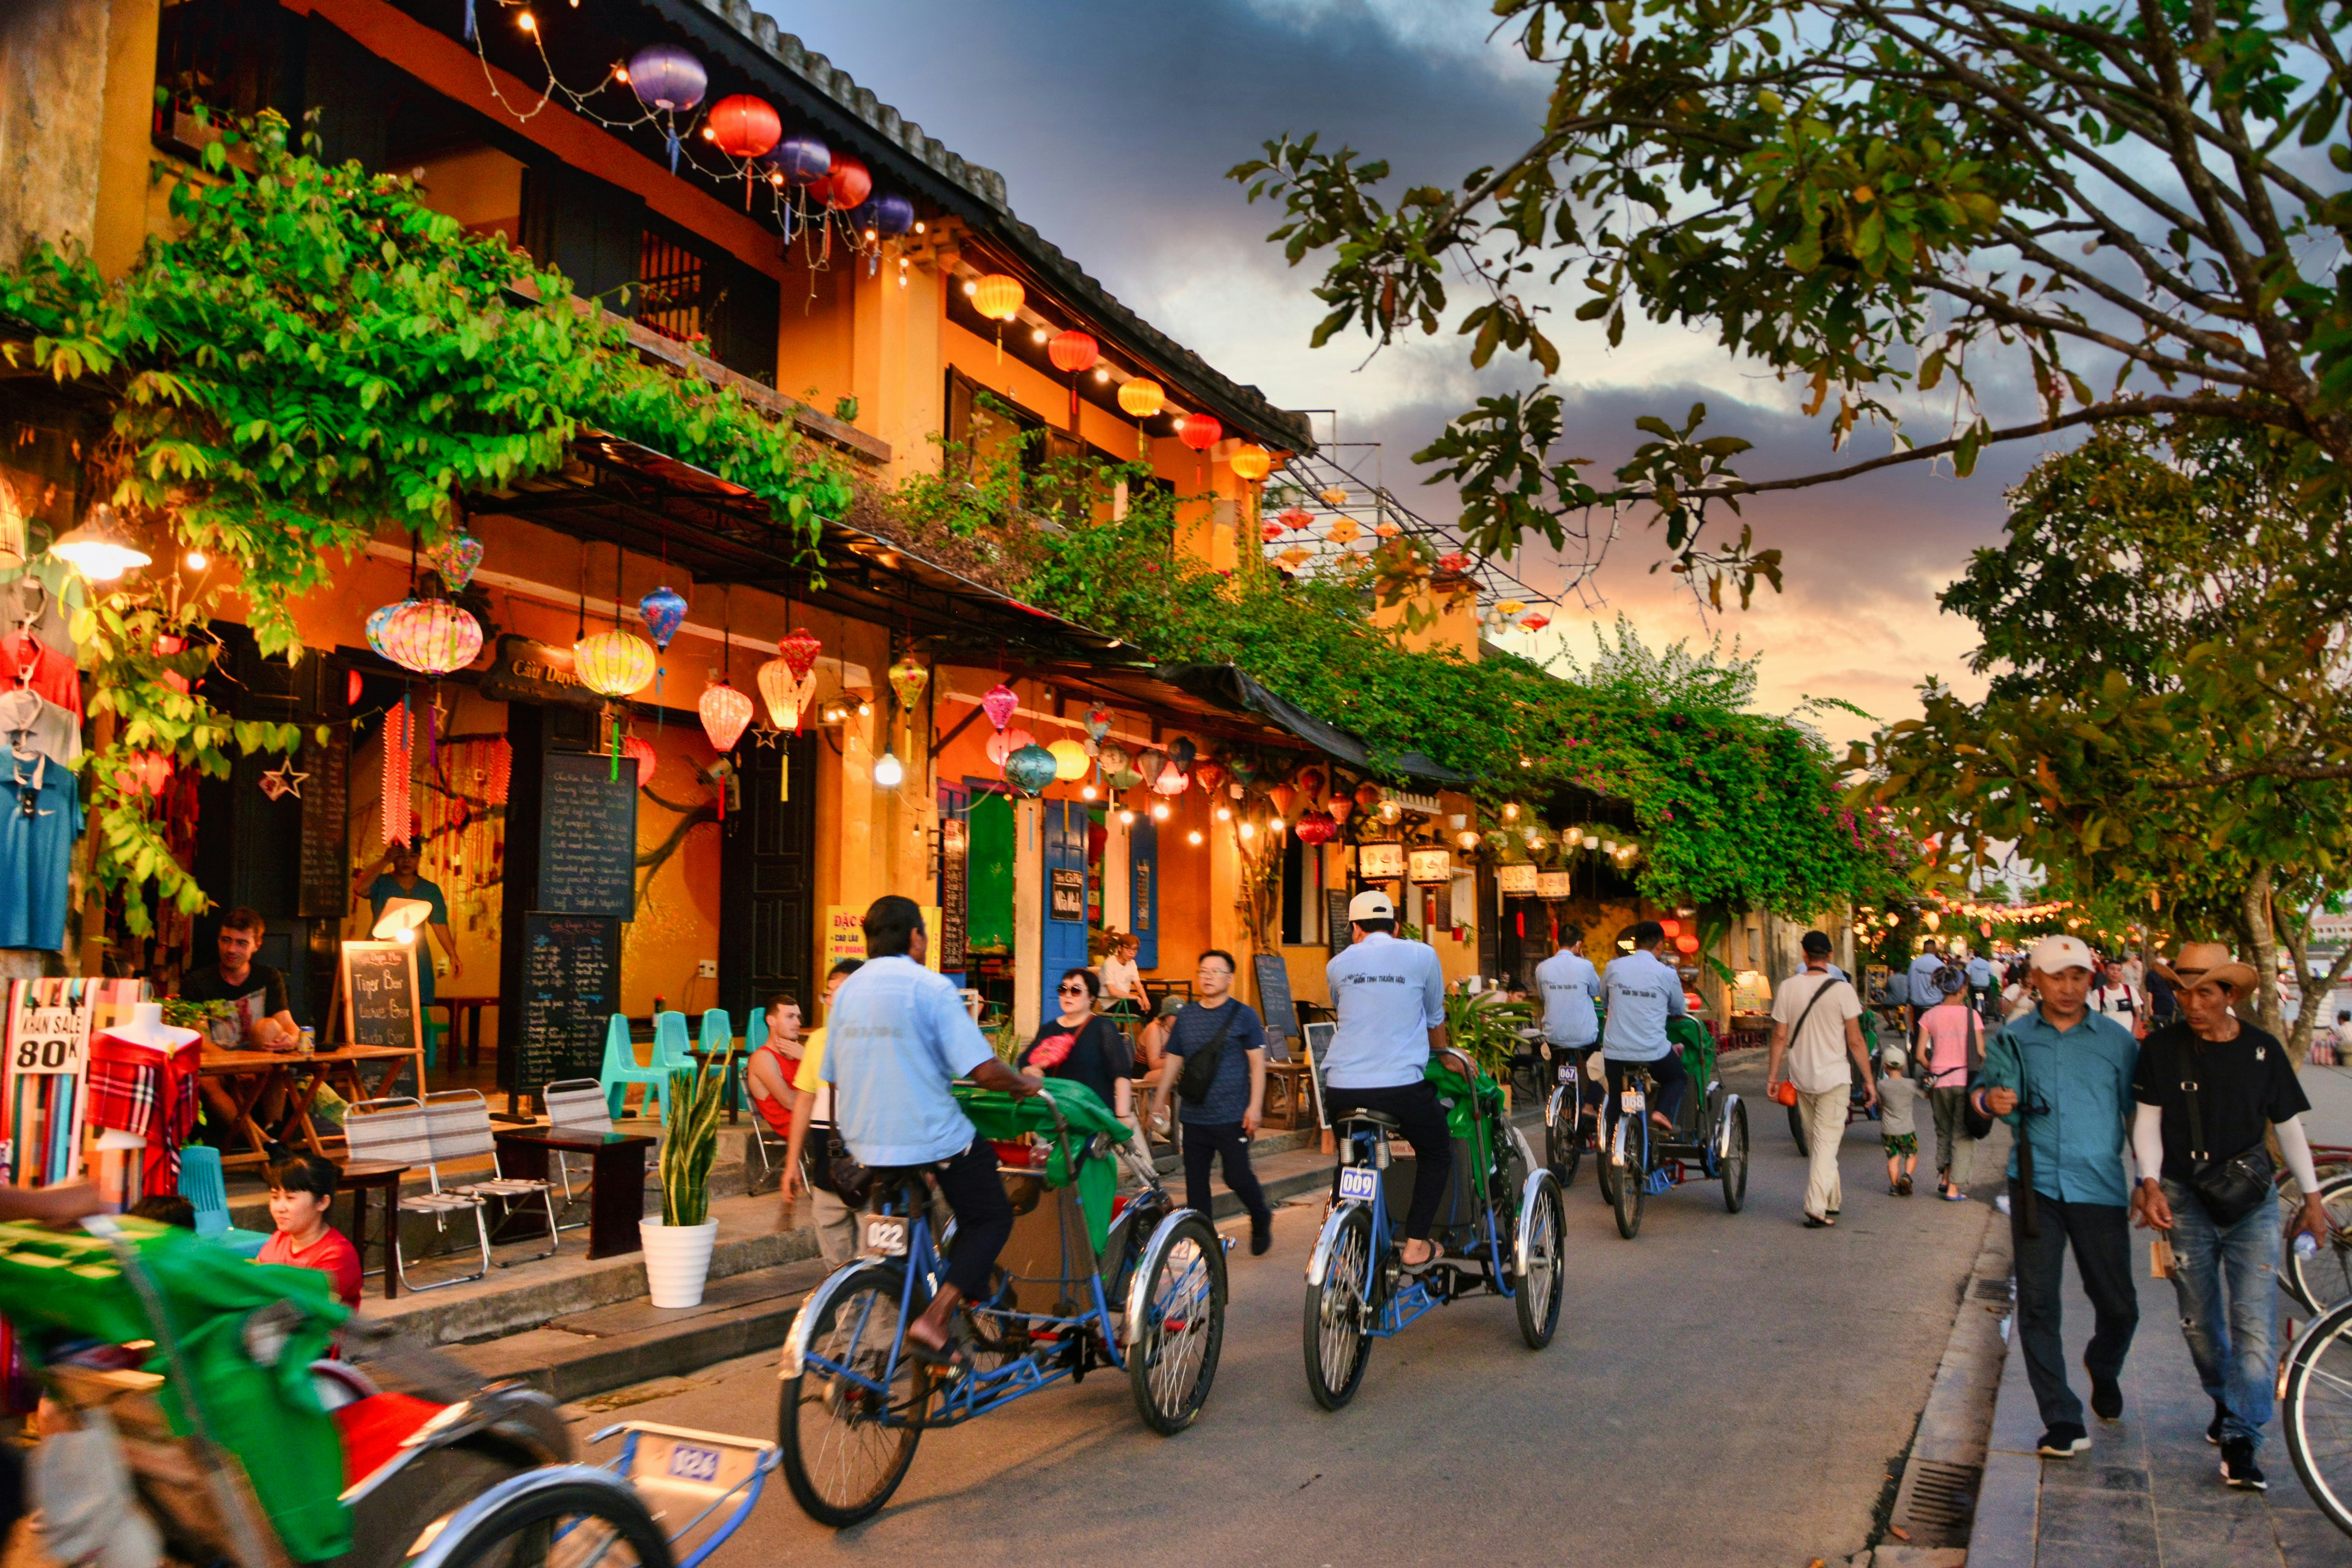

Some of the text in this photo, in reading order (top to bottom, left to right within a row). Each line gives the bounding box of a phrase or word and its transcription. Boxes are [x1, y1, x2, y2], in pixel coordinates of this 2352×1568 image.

[833, 912, 856, 930] ĐẶC
[54, 1016, 80, 1034] SALE
[1561, 1068, 1575, 1078] 067
[1622, 1095, 1644, 1107] 068
[1343, 1174, 1372, 1195] 009
